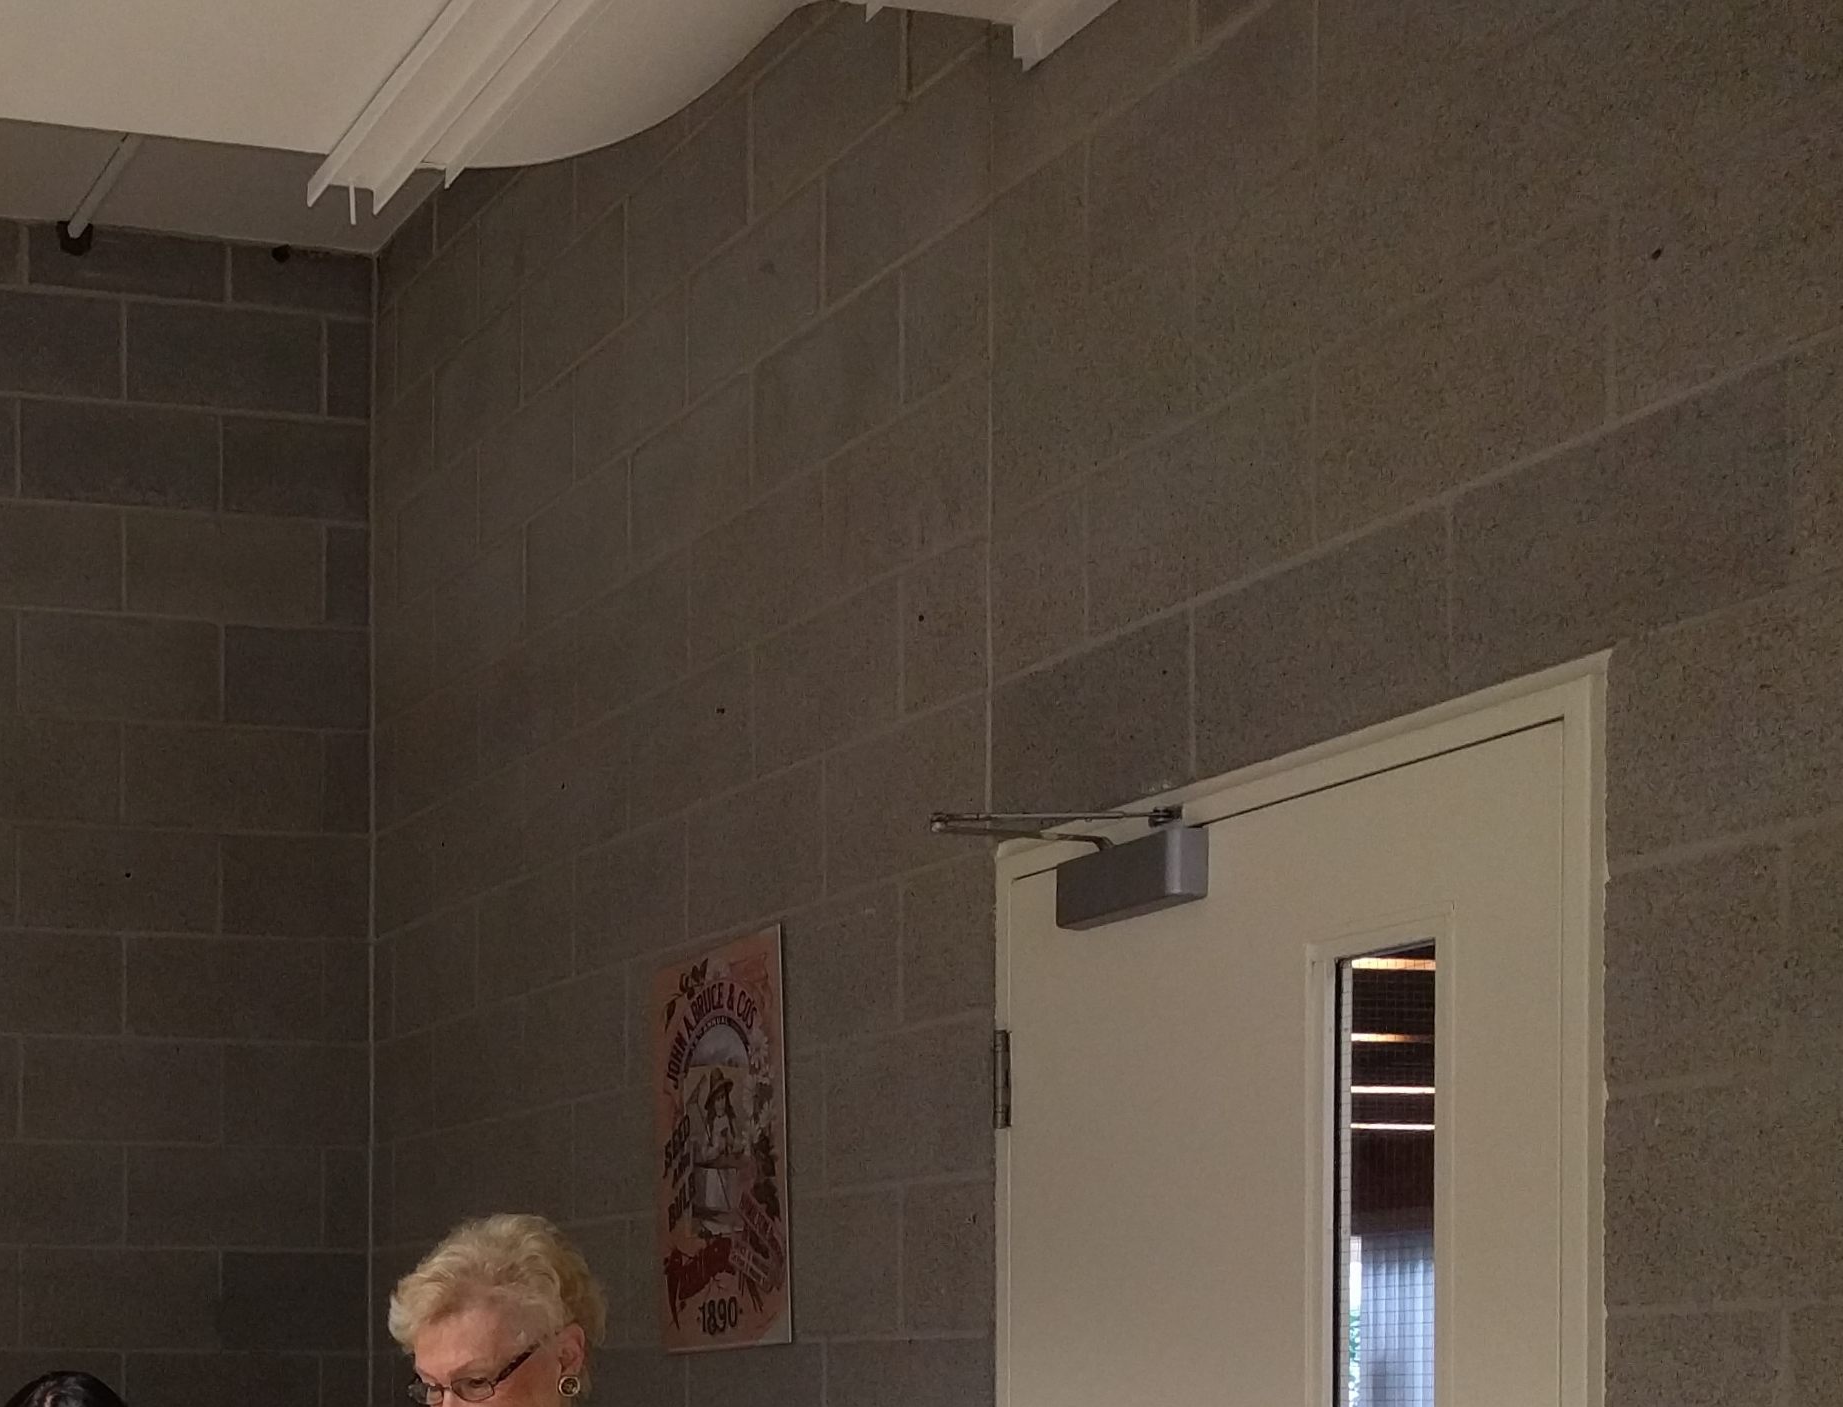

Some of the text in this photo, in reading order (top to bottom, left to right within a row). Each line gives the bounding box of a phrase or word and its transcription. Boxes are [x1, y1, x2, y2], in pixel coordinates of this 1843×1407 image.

[666, 1031, 688, 1090] JOHN
[690, 982, 724, 1023] BRUCE
[727, 983, 735, 1010] &
[699, 1296, 738, 1338] 1890
